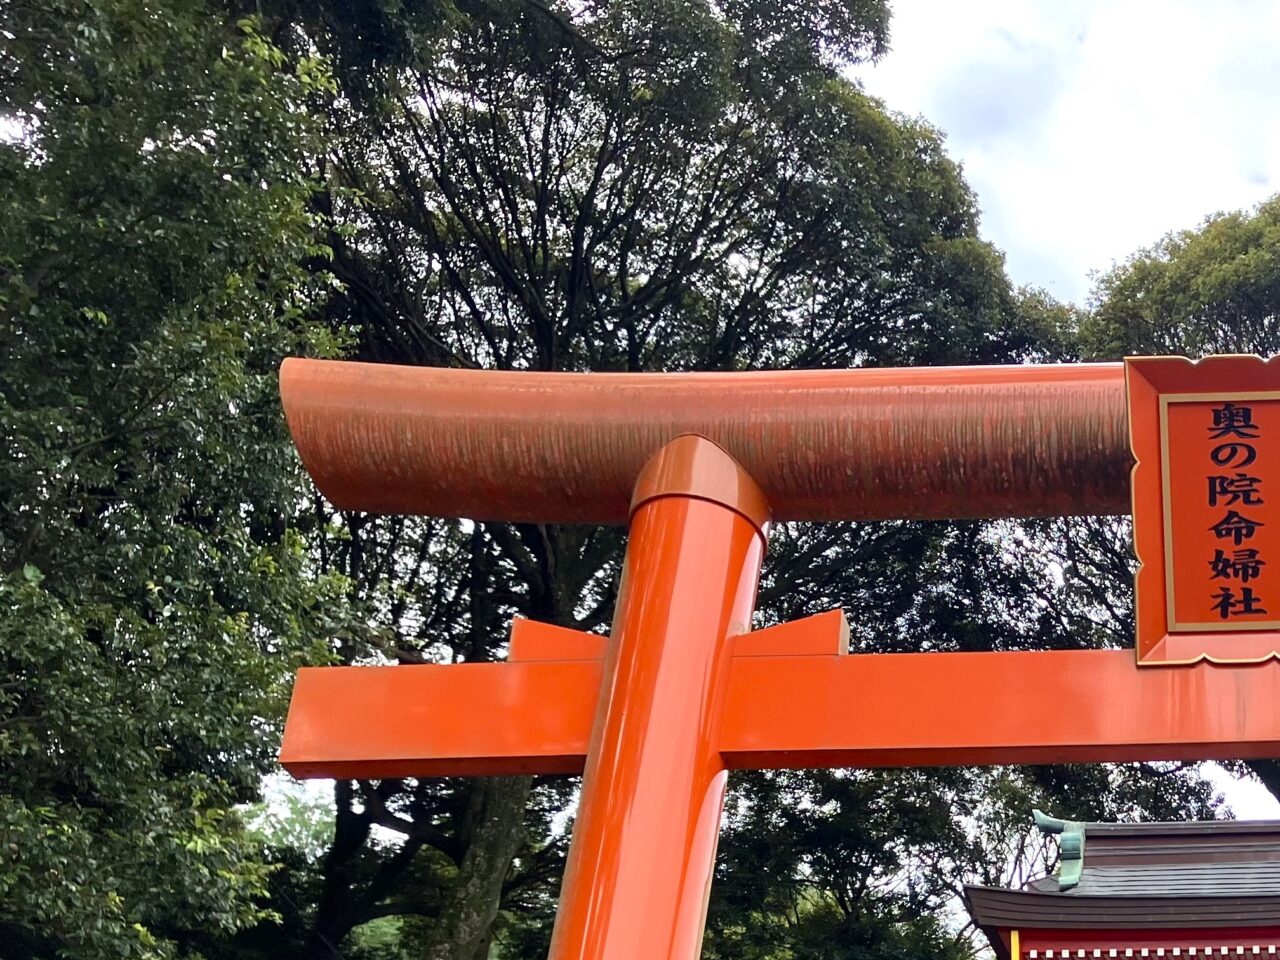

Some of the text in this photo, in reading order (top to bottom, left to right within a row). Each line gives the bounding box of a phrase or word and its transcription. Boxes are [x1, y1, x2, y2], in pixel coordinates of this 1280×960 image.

[1206, 403, 1268, 619] 奥の院命婦社
